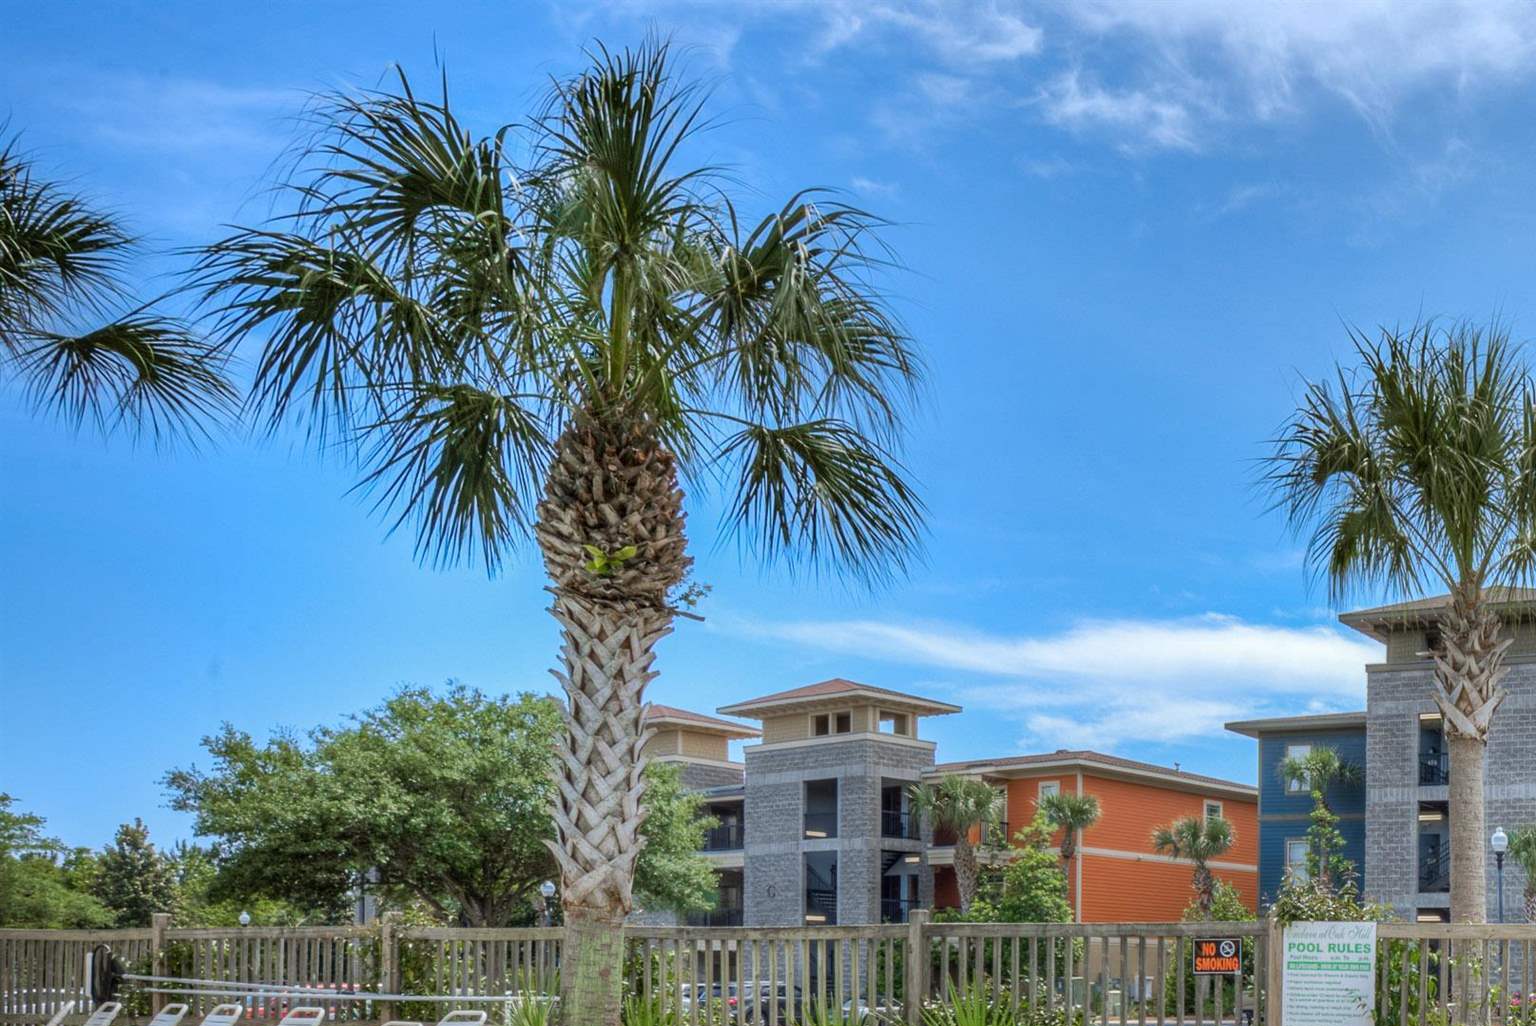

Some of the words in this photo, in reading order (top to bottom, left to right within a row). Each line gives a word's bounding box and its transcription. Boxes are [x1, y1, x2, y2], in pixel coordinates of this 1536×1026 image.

[1202, 942, 1216, 957] NO
[1288, 943, 1323, 953] POOL
[1328, 943, 1371, 954] RULES
[1196, 957, 1239, 971] SMOKING
